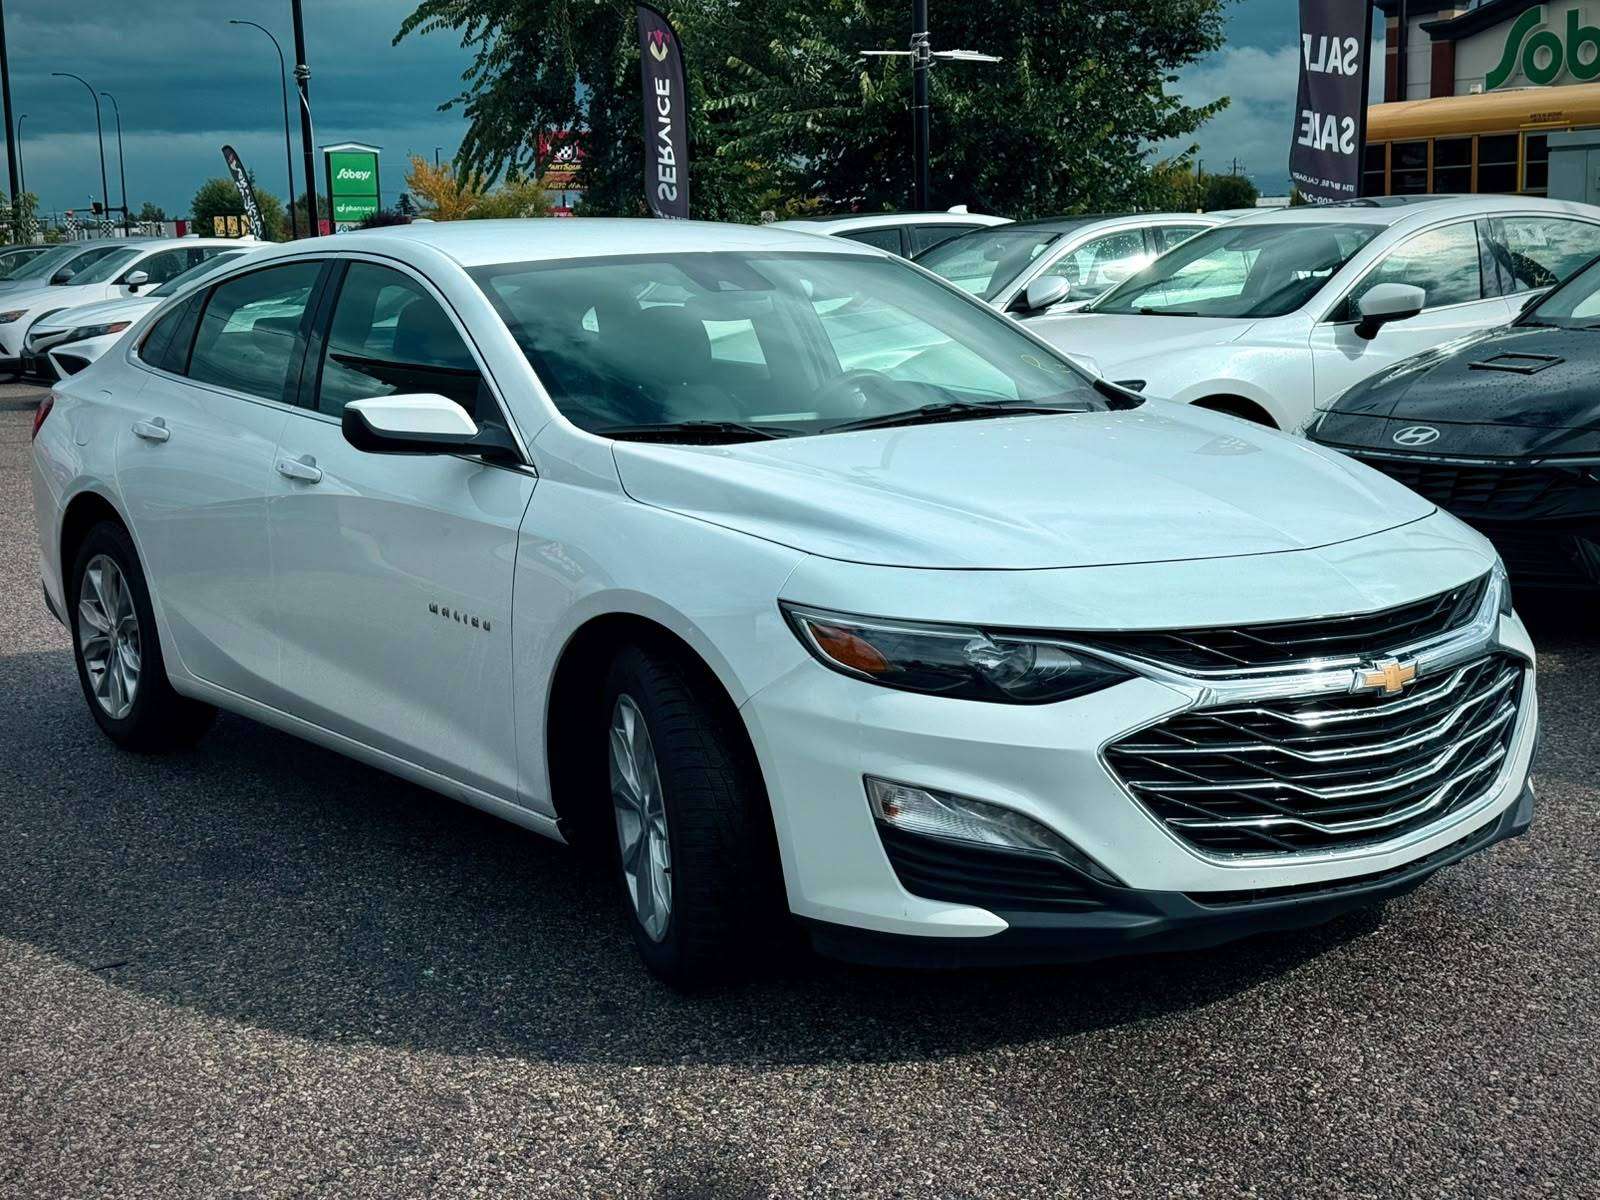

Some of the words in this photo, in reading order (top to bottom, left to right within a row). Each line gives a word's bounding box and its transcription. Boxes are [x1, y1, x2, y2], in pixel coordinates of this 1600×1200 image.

[1485, 5, 1600, 90] Sob
[337, 168, 371, 180] Sobeys
[429, 603, 491, 632] MALIBU
